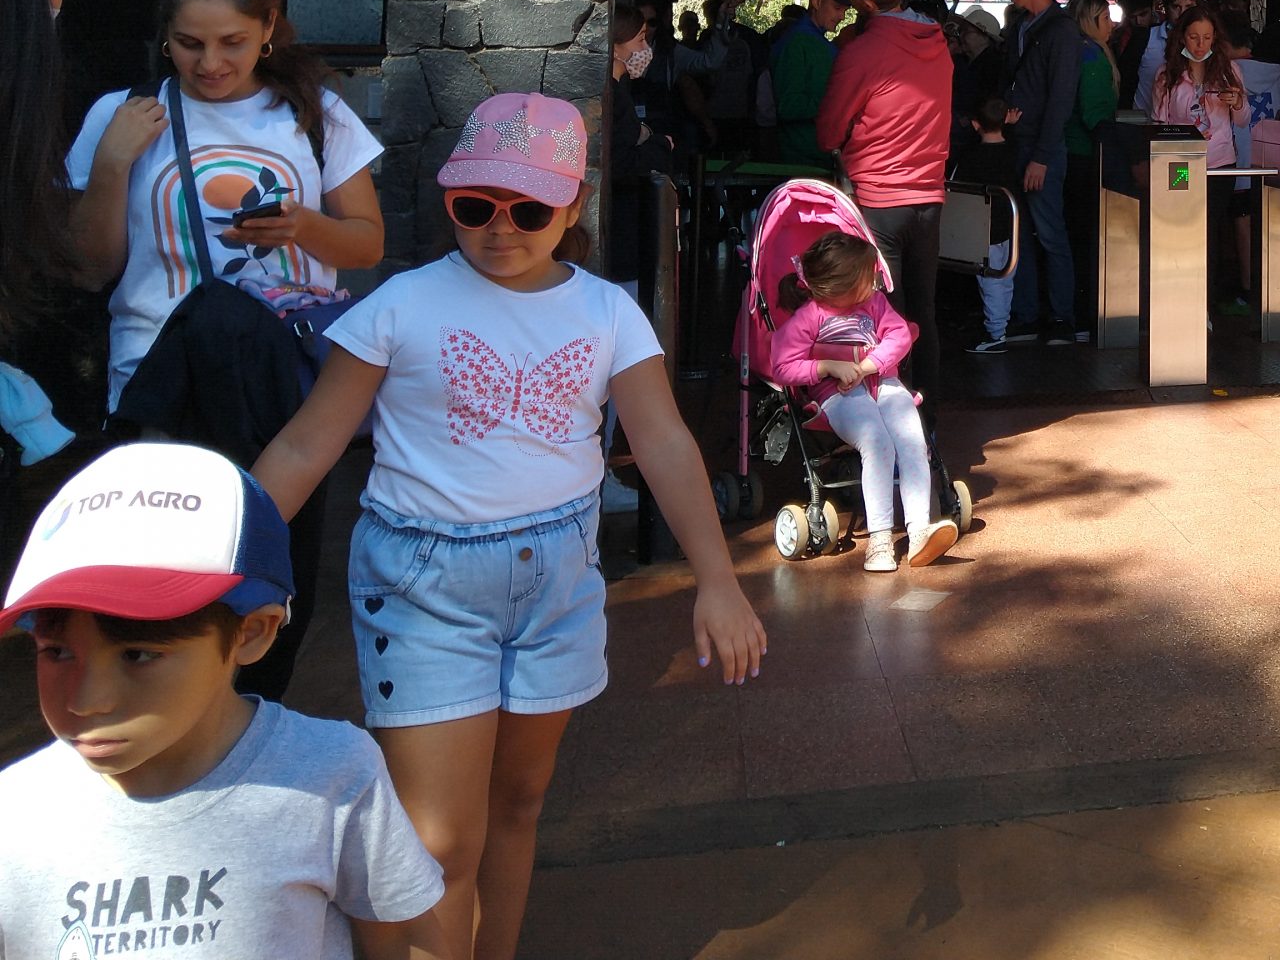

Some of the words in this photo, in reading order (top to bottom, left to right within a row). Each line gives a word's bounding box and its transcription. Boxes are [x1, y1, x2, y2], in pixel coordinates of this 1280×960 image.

[78, 490, 123, 515] TOP
[128, 490, 202, 512] AGRO
[60, 866, 229, 930] SHARK
[91, 919, 223, 956] TERRITORY
